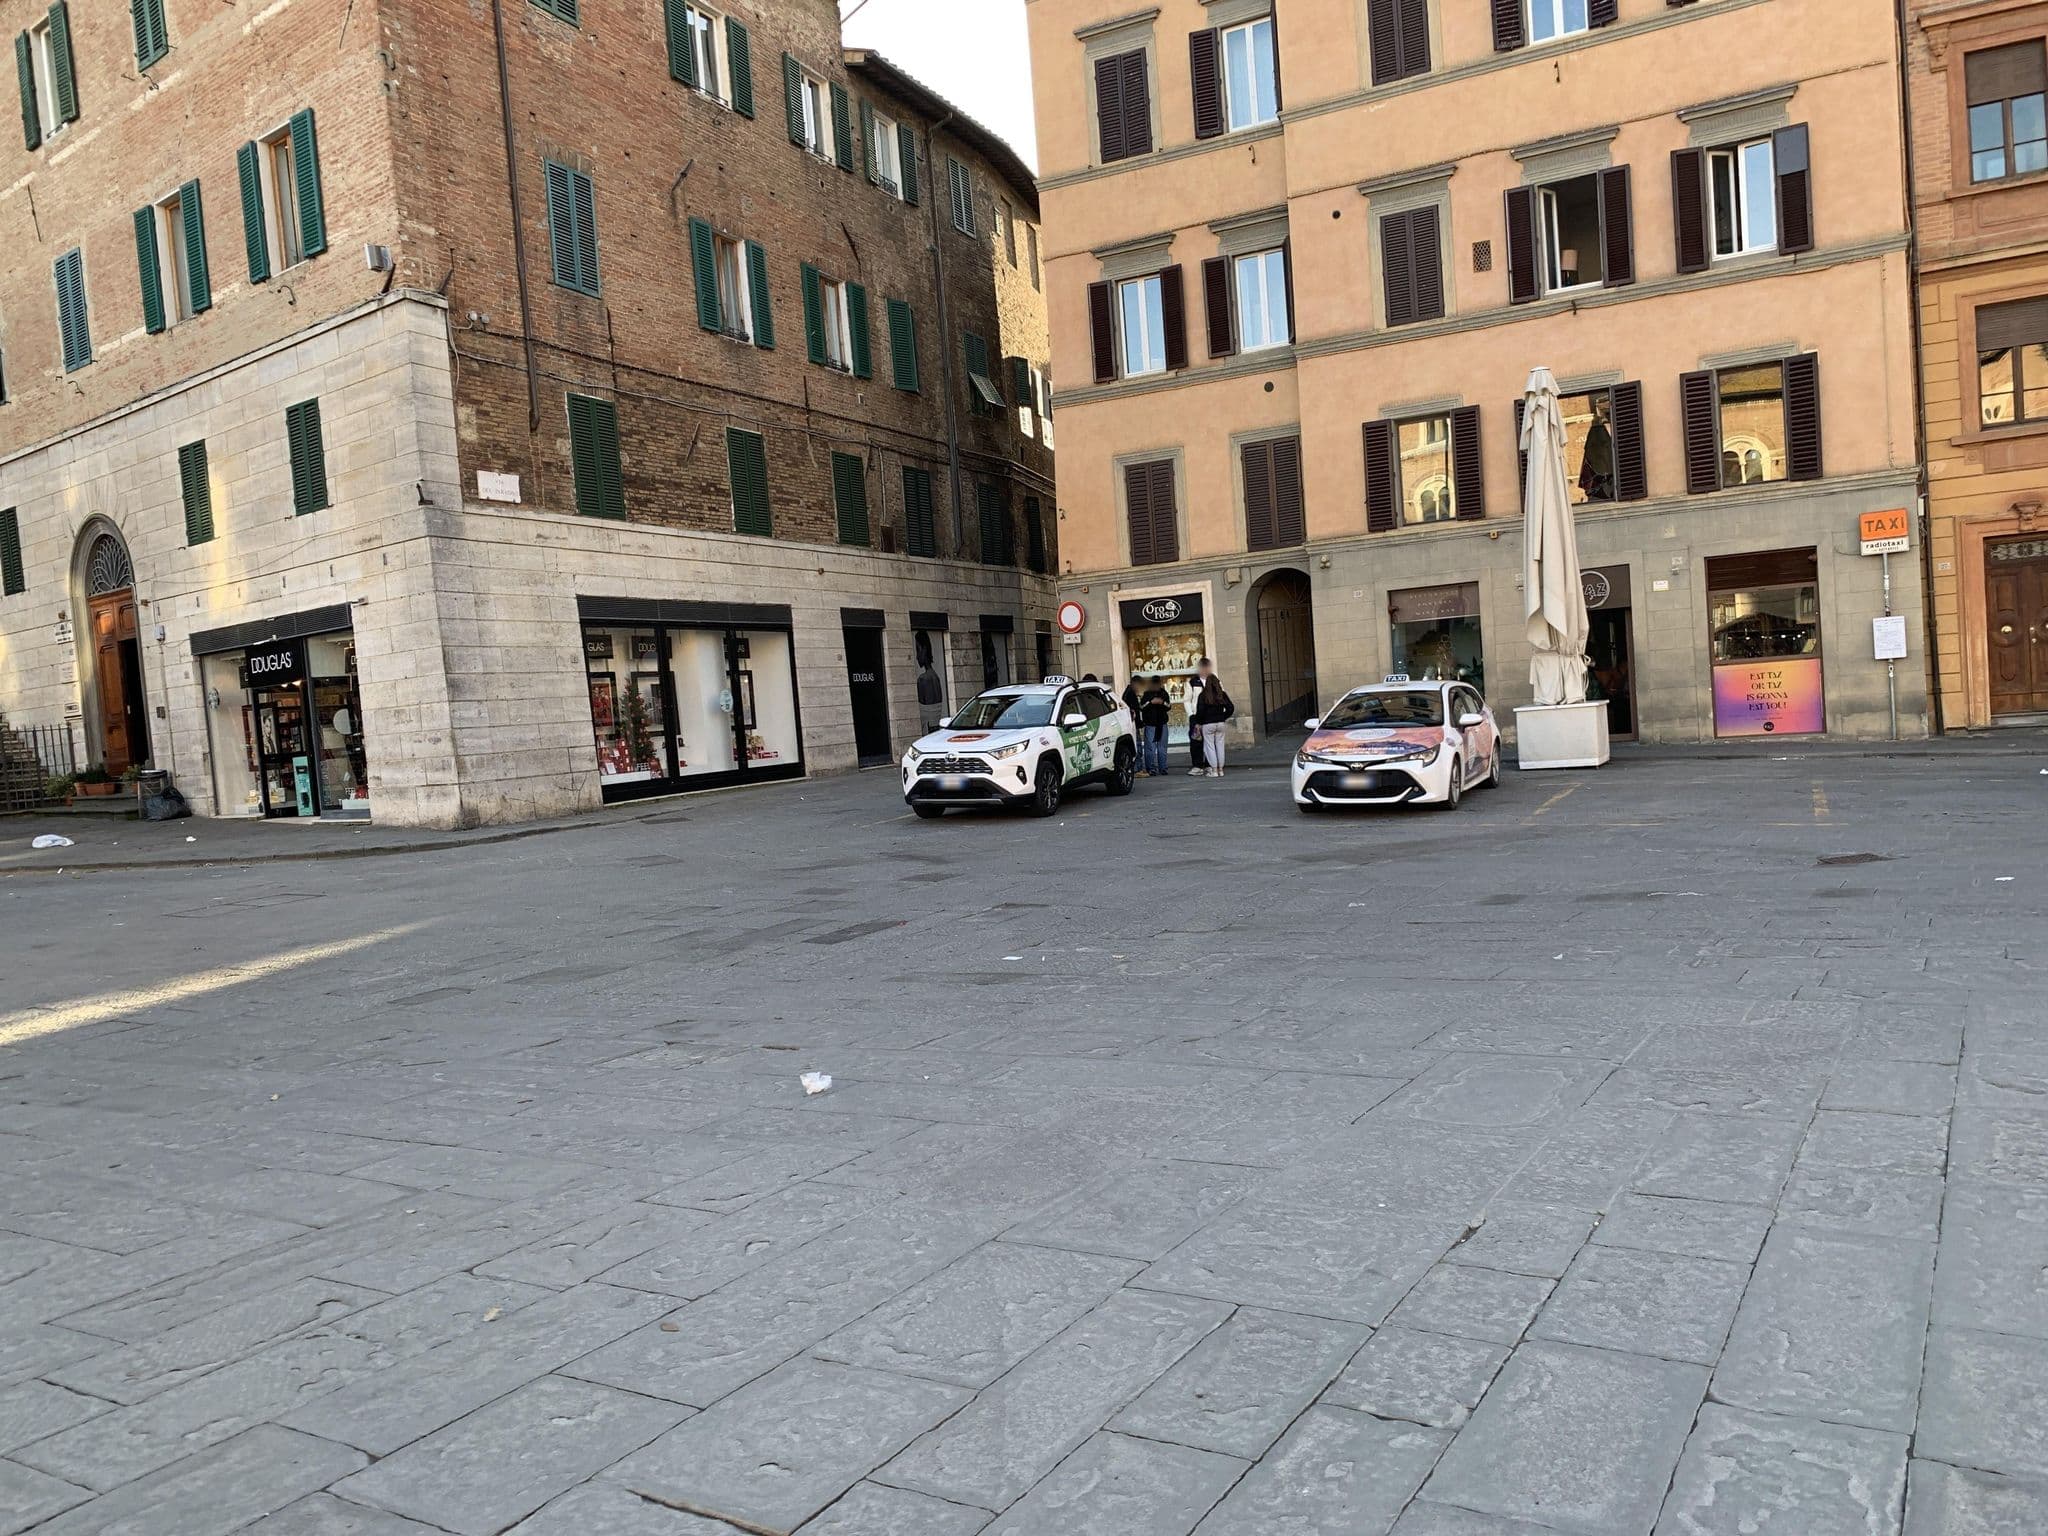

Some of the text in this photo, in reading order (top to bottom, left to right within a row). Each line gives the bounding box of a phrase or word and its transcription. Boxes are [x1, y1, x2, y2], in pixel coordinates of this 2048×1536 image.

[1864, 516, 1905, 532] TAXI
[1866, 540, 1904, 548] radiotaxi
[1146, 604, 1164, 614] Oro
[1155, 609, 1174, 619] rosa
[587, 642, 605, 652] GLAS
[251, 652, 292, 673] DOUGLAS
[1046, 675, 1065, 684] TAXI
[1757, 691, 1788, 700] GONNA
